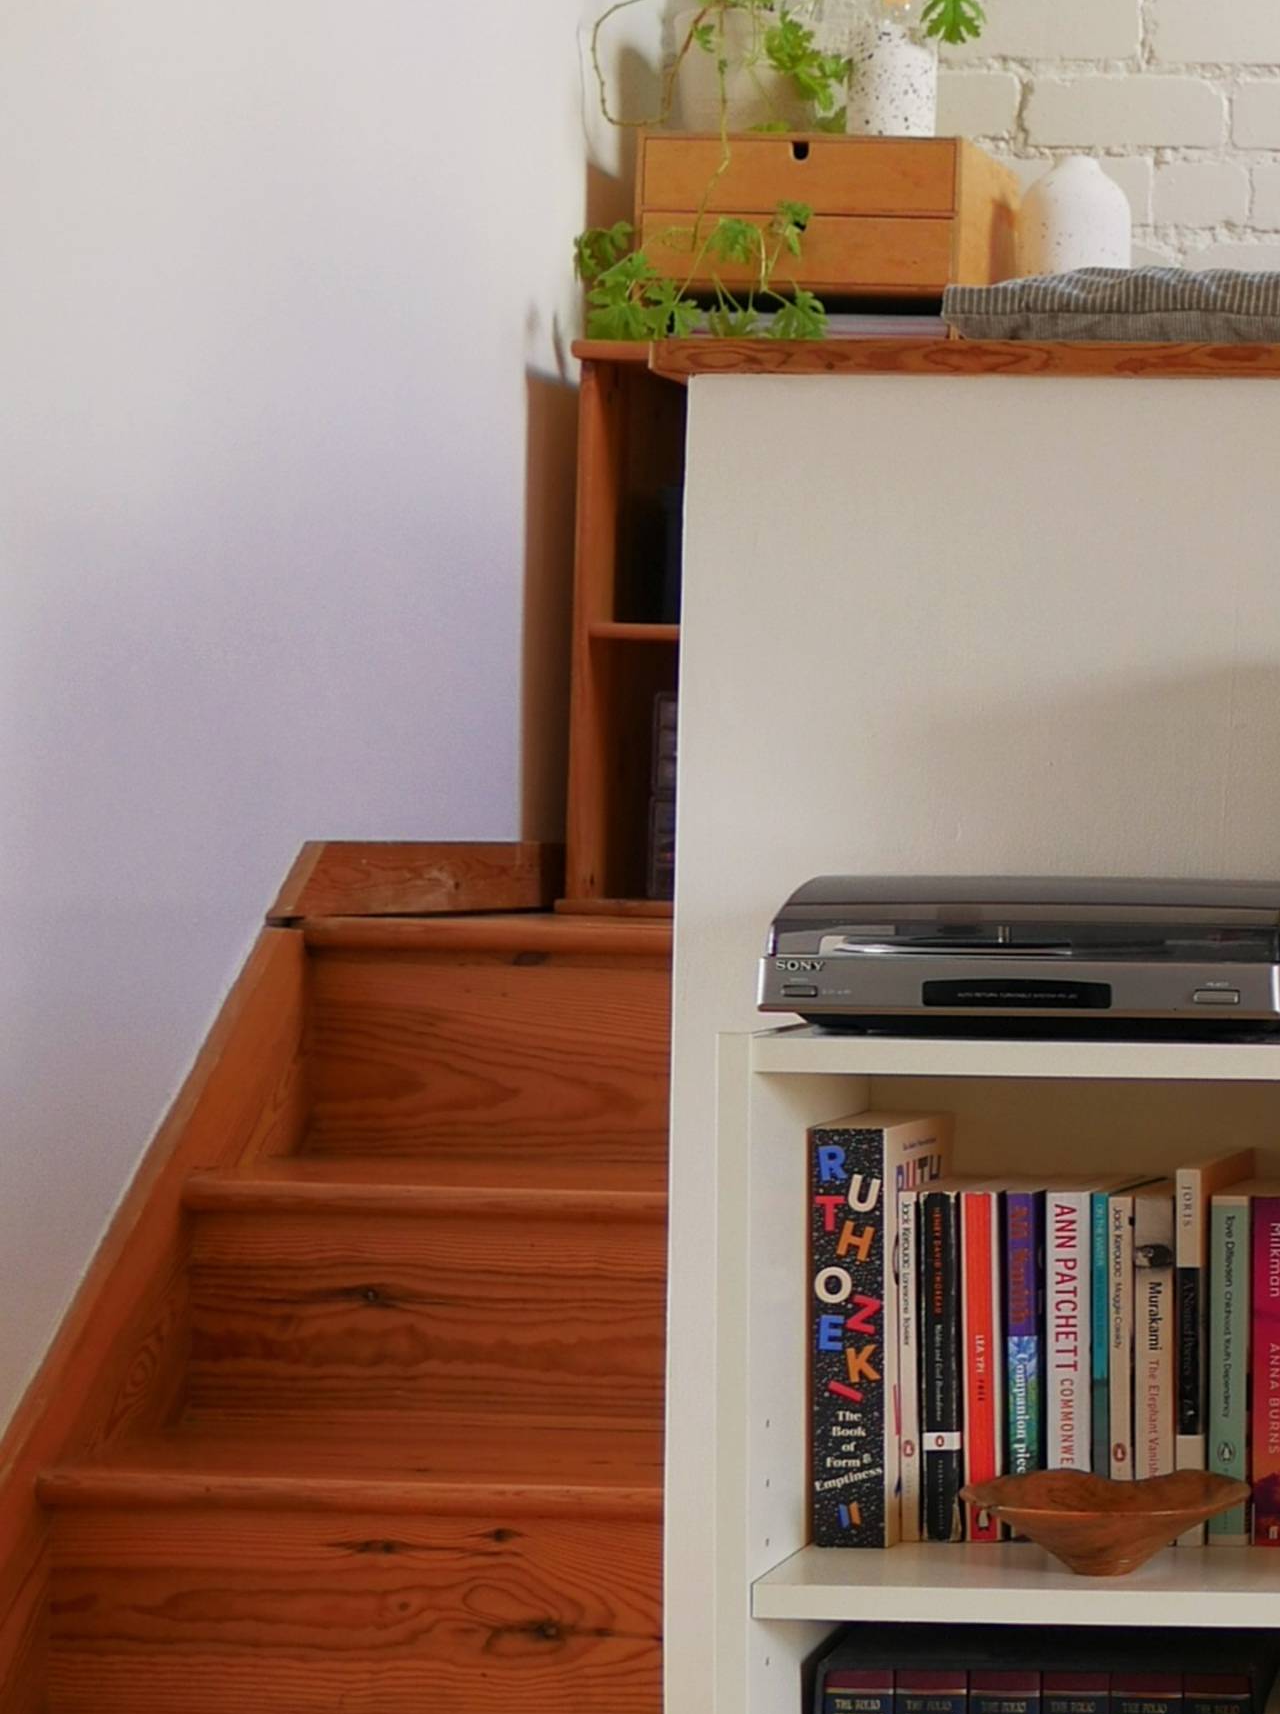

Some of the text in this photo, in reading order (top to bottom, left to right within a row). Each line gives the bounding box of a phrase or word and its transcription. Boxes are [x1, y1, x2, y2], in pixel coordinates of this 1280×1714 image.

[775, 959, 826, 972] SONY
[1112, 1208, 1122, 1231] Jack
[1113, 1235, 1122, 1277] Kerouac
[1147, 1282, 1161, 1350] Murakami
[1053, 1205, 1076, 1464] ANN PATCHETT COMMONWE
[1147, 1360, 1158, 1379] The
[1146, 1385, 1158, 1434] Elephant
[1268, 1344, 1279, 1453] ANNA BURNS
[837, 1411, 861, 1421] The
[1014, 1354, 1028, 1473] Companion piec
[832, 1425, 866, 1438] Book
[841, 1442, 855, 1452] of
[826, 1456, 860, 1468] Form
[815, 1466, 883, 1491] Emptiness
